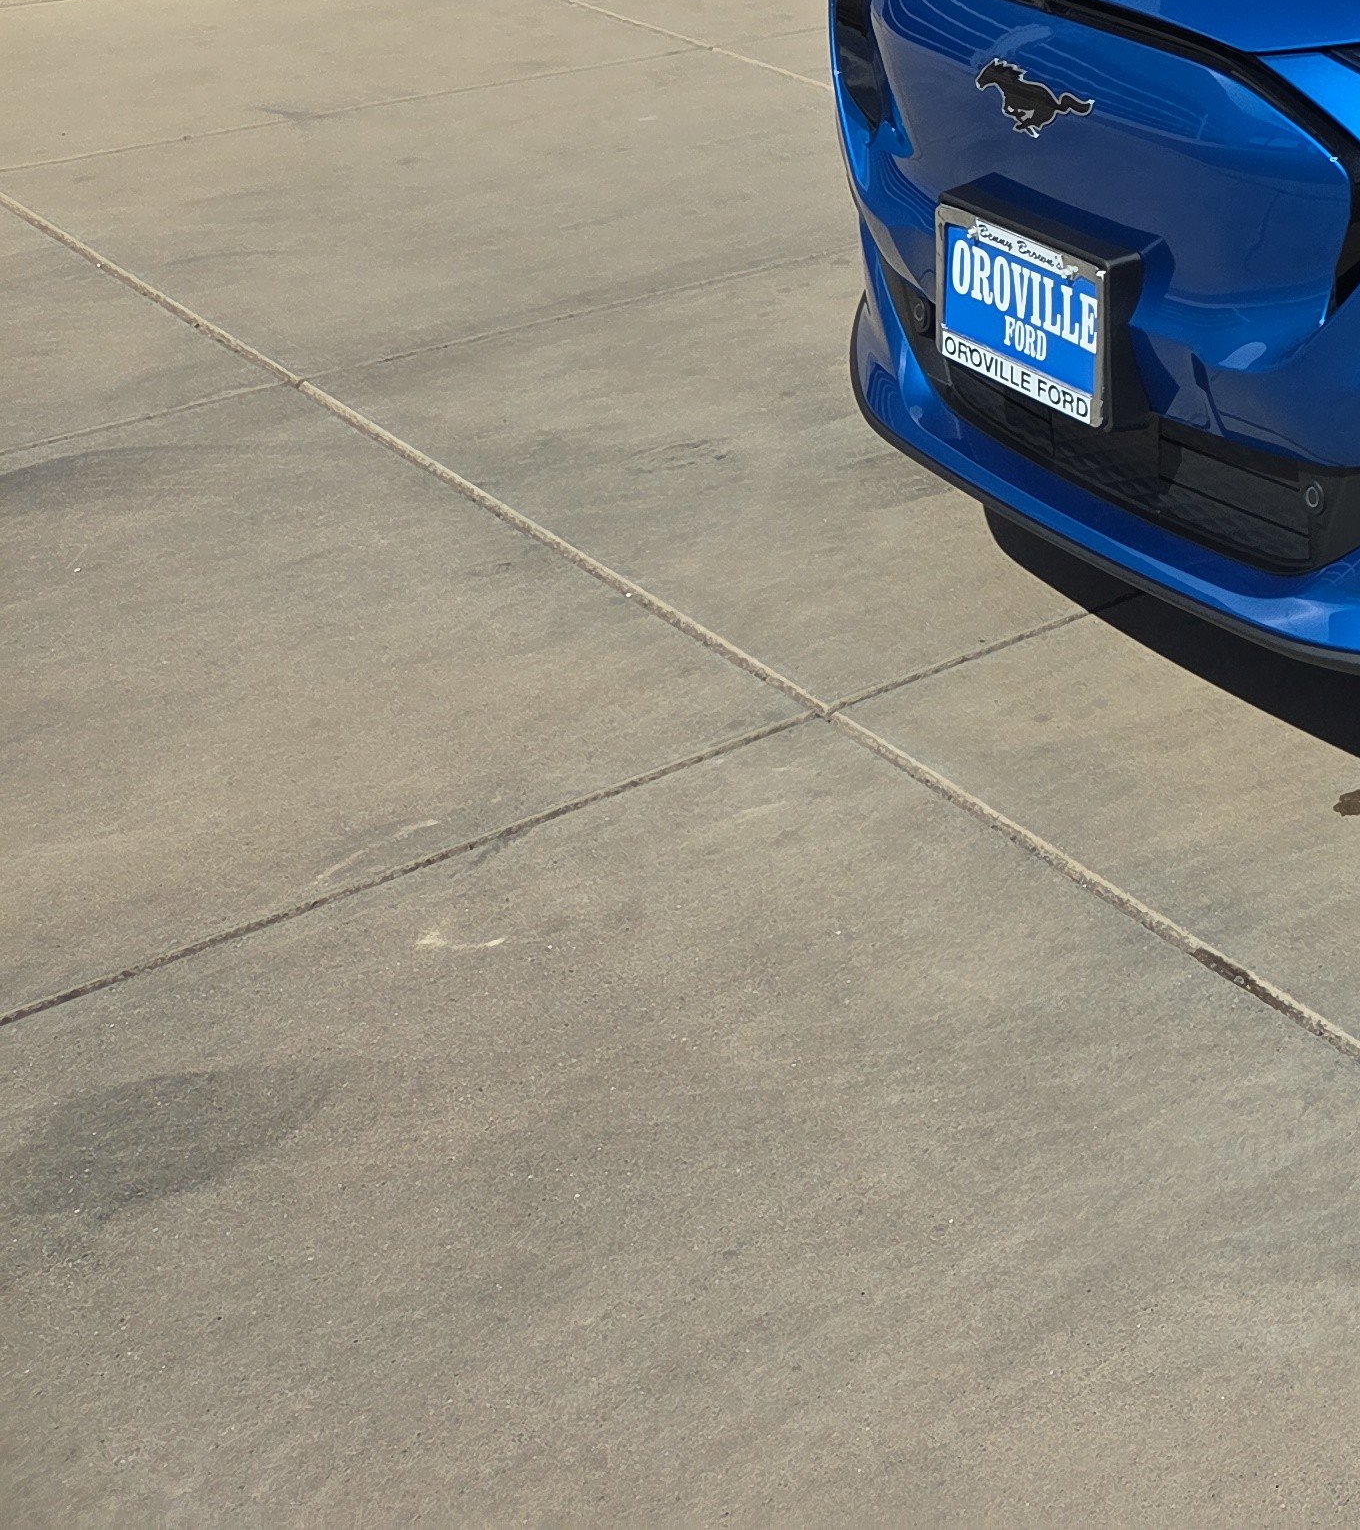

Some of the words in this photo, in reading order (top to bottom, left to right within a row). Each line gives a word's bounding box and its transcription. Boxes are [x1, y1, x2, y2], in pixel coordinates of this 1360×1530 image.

[977, 224, 1014, 252] Benny
[952, 240, 1098, 354] OROVILLE
[1004, 316, 1047, 361] FORD
[944, 336, 1032, 392] OROVILLE
[1037, 378, 1088, 418] FORD
